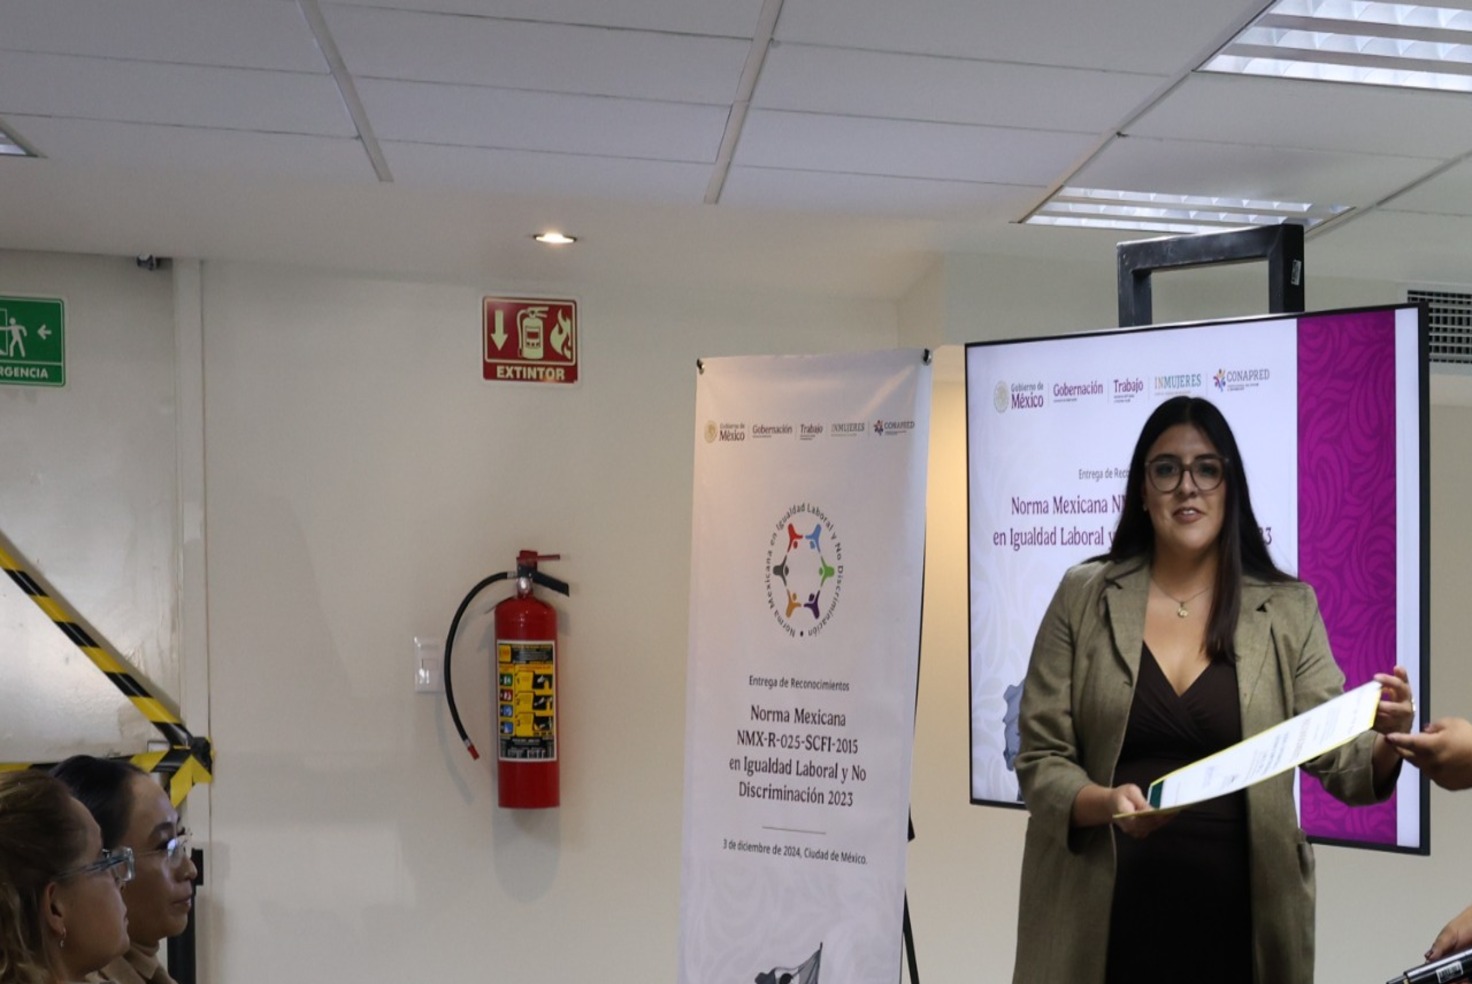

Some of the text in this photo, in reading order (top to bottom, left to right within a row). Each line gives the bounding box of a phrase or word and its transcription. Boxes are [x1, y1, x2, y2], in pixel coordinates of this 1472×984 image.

[496, 365, 565, 380] EXTINTOR
[1154, 373, 1202, 389] INMUJERES
[1226, 368, 1270, 382] CONAPRED
[1053, 380, 1104, 397] Gobernación
[1114, 378, 1143, 393] Trabajo
[1011, 392, 1044, 410] México
[719, 428, 745, 441] México
[752, 423, 793, 435] Gobernación
[1078, 468, 1104, 482] Entrega
[1104, 468, 1113, 479] de
[1011, 496, 1049, 515] Norma
[1052, 495, 1108, 514] Mexicana
[993, 531, 1006, 546] en
[1010, 526, 1056, 551] Igualdad
[1060, 526, 1104, 546] Laboral
[749, 675, 850, 692] Entrega de Reconocimientos
[750, 704, 846, 727] Norma Mexicana
[736, 729, 859, 755] NMX-R-025-SCFI-2015
[729, 756, 867, 784] en Igualdad Laboral y No
[738, 781, 853, 807] Discriminación 2023
[723, 838, 728, 849] 3
[728, 839, 737, 850] de
[737, 840, 771, 854] diciembre
[772, 843, 782, 855] de
[803, 847, 829, 861] Ciudad
[830, 850, 839, 862] de
